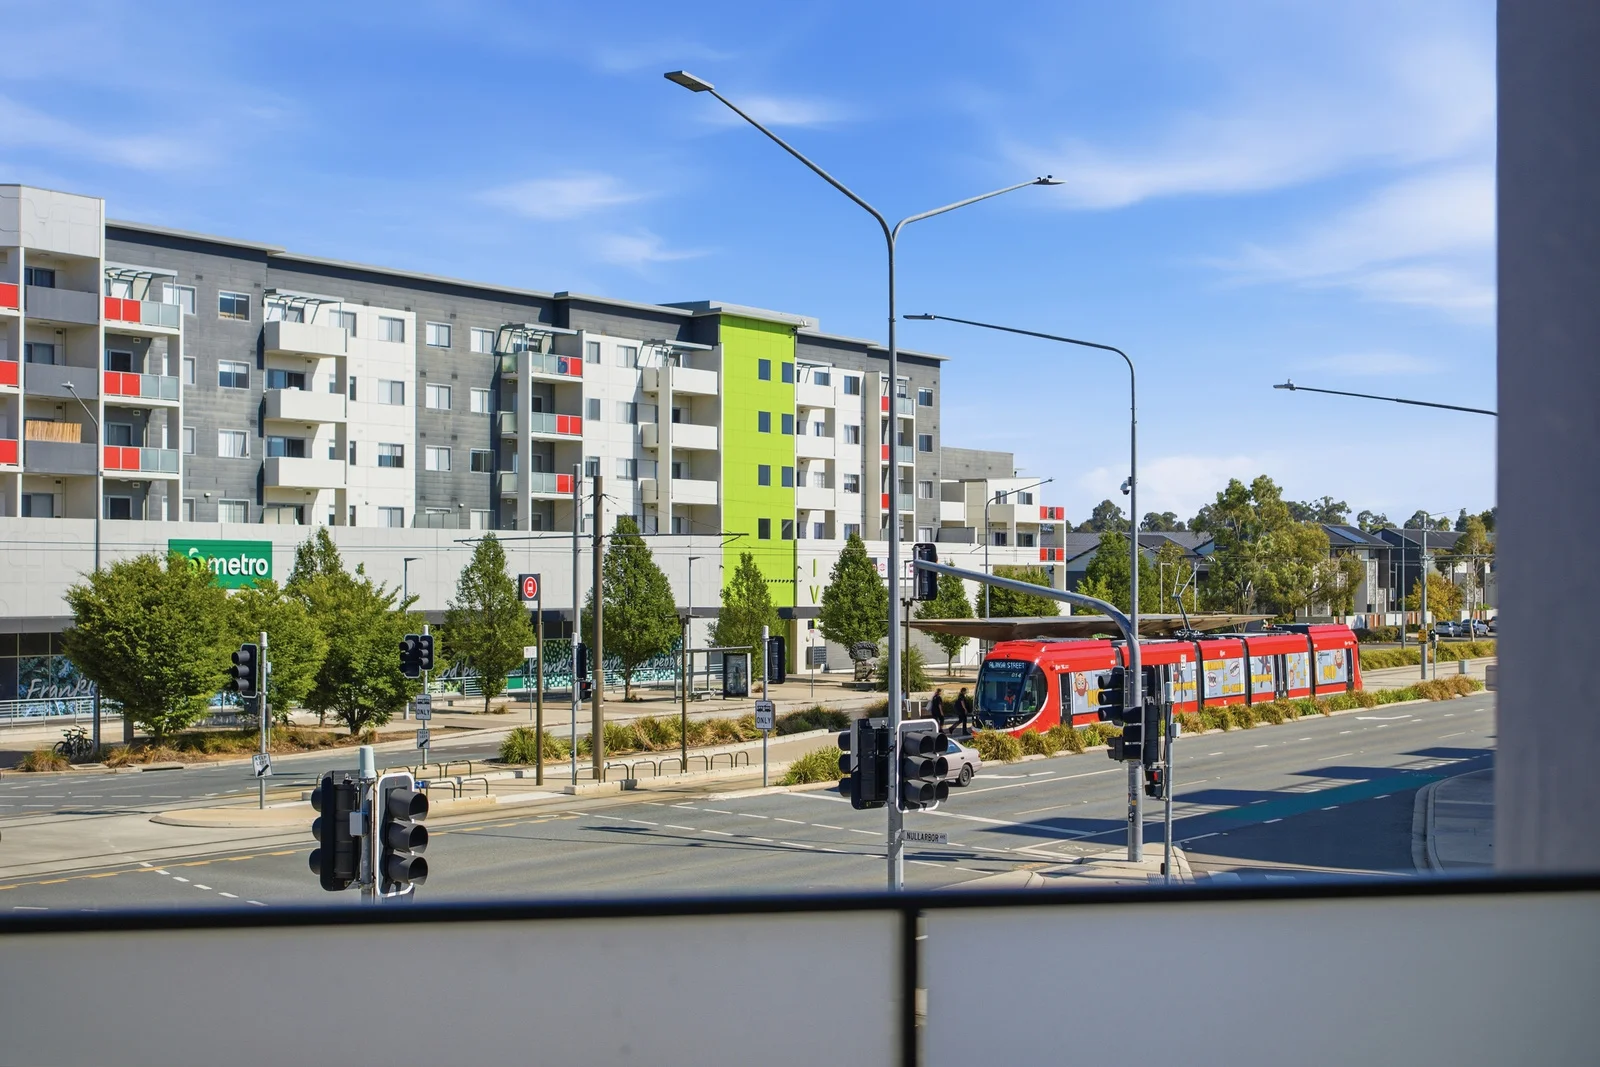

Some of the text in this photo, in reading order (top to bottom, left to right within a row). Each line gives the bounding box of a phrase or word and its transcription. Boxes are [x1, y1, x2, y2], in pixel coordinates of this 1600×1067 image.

[208, 553, 269, 576] metro
[757, 716, 772, 724] ONLY
[907, 832, 939, 841] NULLARBOR
